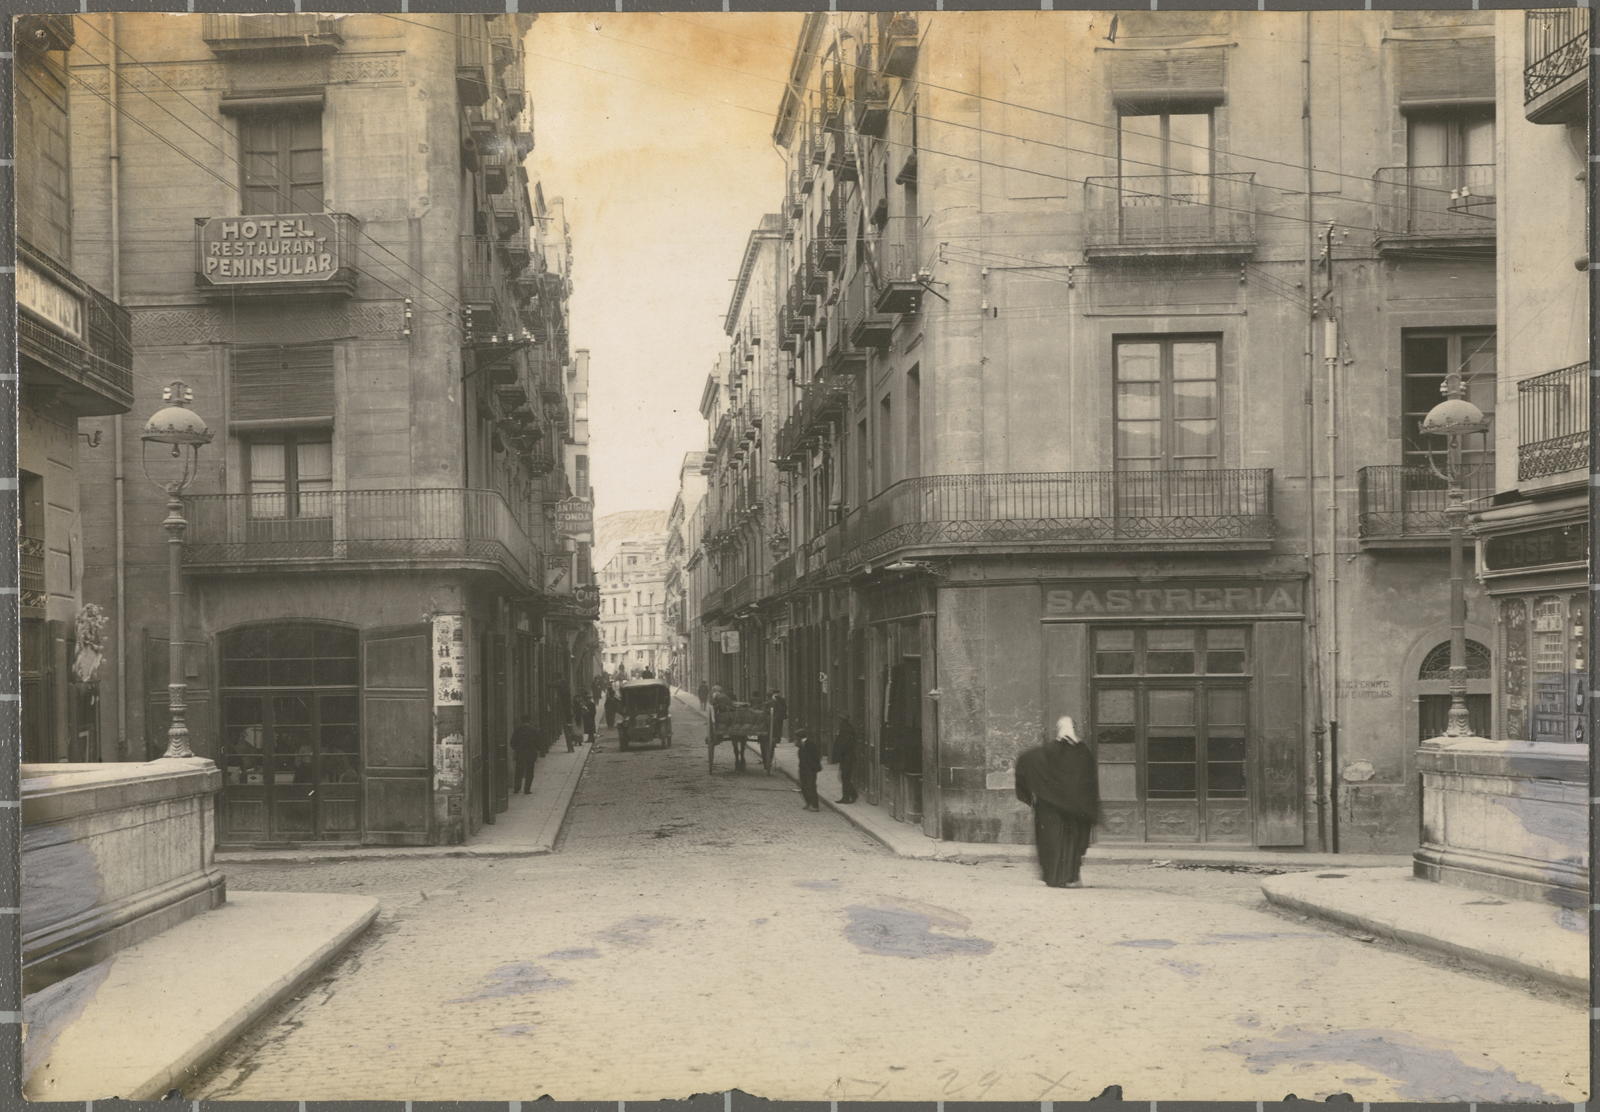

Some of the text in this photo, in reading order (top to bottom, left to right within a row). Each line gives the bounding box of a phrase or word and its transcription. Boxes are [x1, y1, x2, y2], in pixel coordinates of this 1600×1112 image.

[221, 219, 315, 240] HOTEL
[210, 237, 327, 257] RESTAURANT
[206, 253, 332, 277] PENINSULAR
[1046, 587, 1297, 613] SASTRERIA
